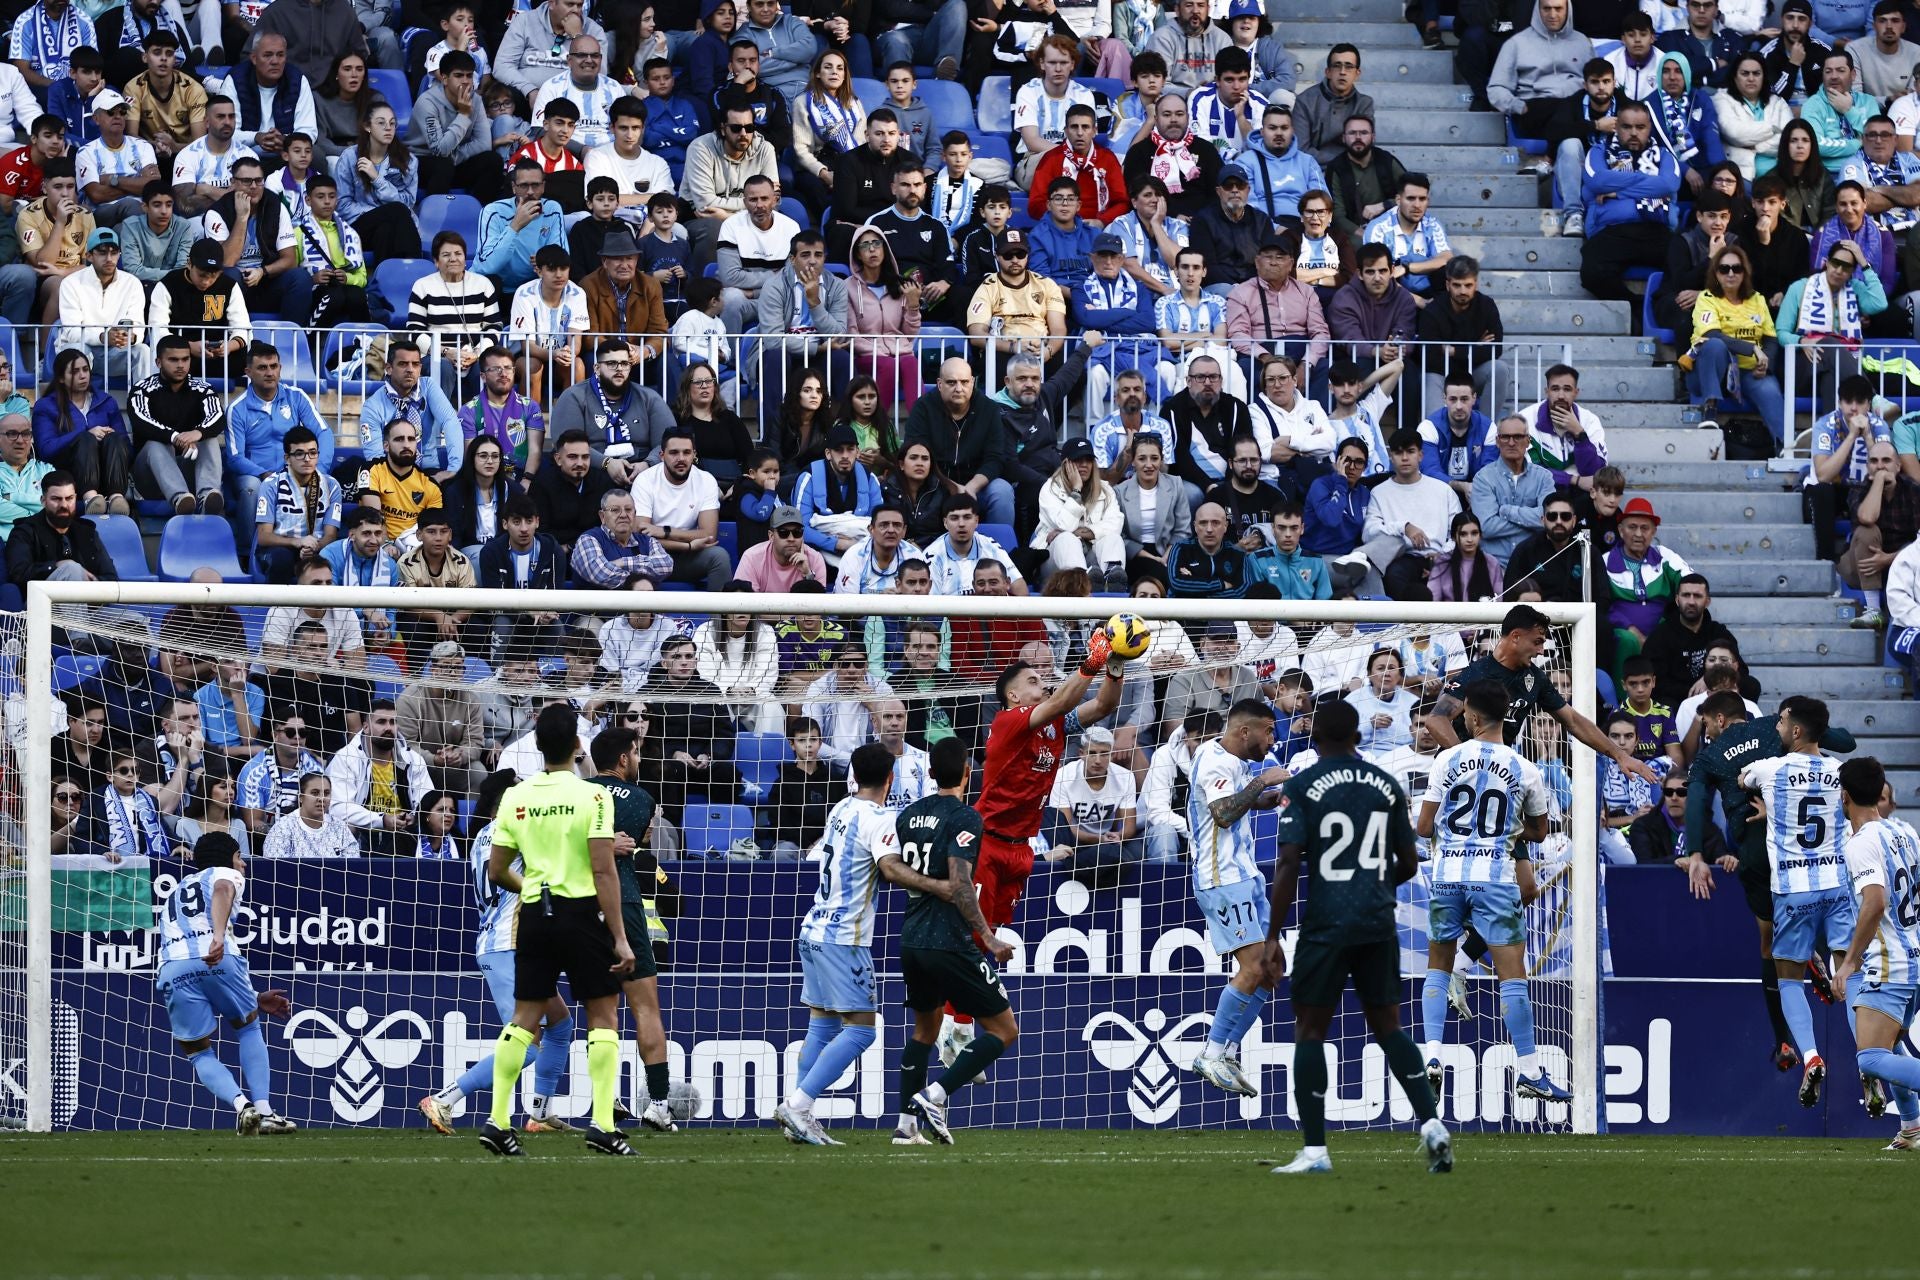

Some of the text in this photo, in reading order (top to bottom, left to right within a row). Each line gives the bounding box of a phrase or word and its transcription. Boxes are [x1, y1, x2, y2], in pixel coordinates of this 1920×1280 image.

[1297, 262, 1340, 270] ARATHO
[204, 295, 225, 321] N
[1643, 343, 1650, 353] 8
[1842, 608, 1849, 618] 5
[1724, 738, 1760, 762] EDGAR
[1306, 769, 1354, 802] BRUNO
[1442, 758, 1521, 798] NELSON MONTE
[1789, 771, 1840, 789] PASTOR
[607, 785, 631, 800] ERO
[1074, 802, 1116, 822] EA7
[1448, 784, 1508, 839] 20
[1796, 796, 1827, 849] 5
[1319, 811, 1390, 882] 24
[1442, 849, 1501, 860] BENAHAVIS
[820, 843, 835, 901] 3
[903, 841, 934, 899] 21
[1779, 854, 1845, 871] BENAHAVIS
[167, 881, 207, 923] 19
[1231, 901, 1253, 924] 17
[232, 905, 387, 945] Ciudad
